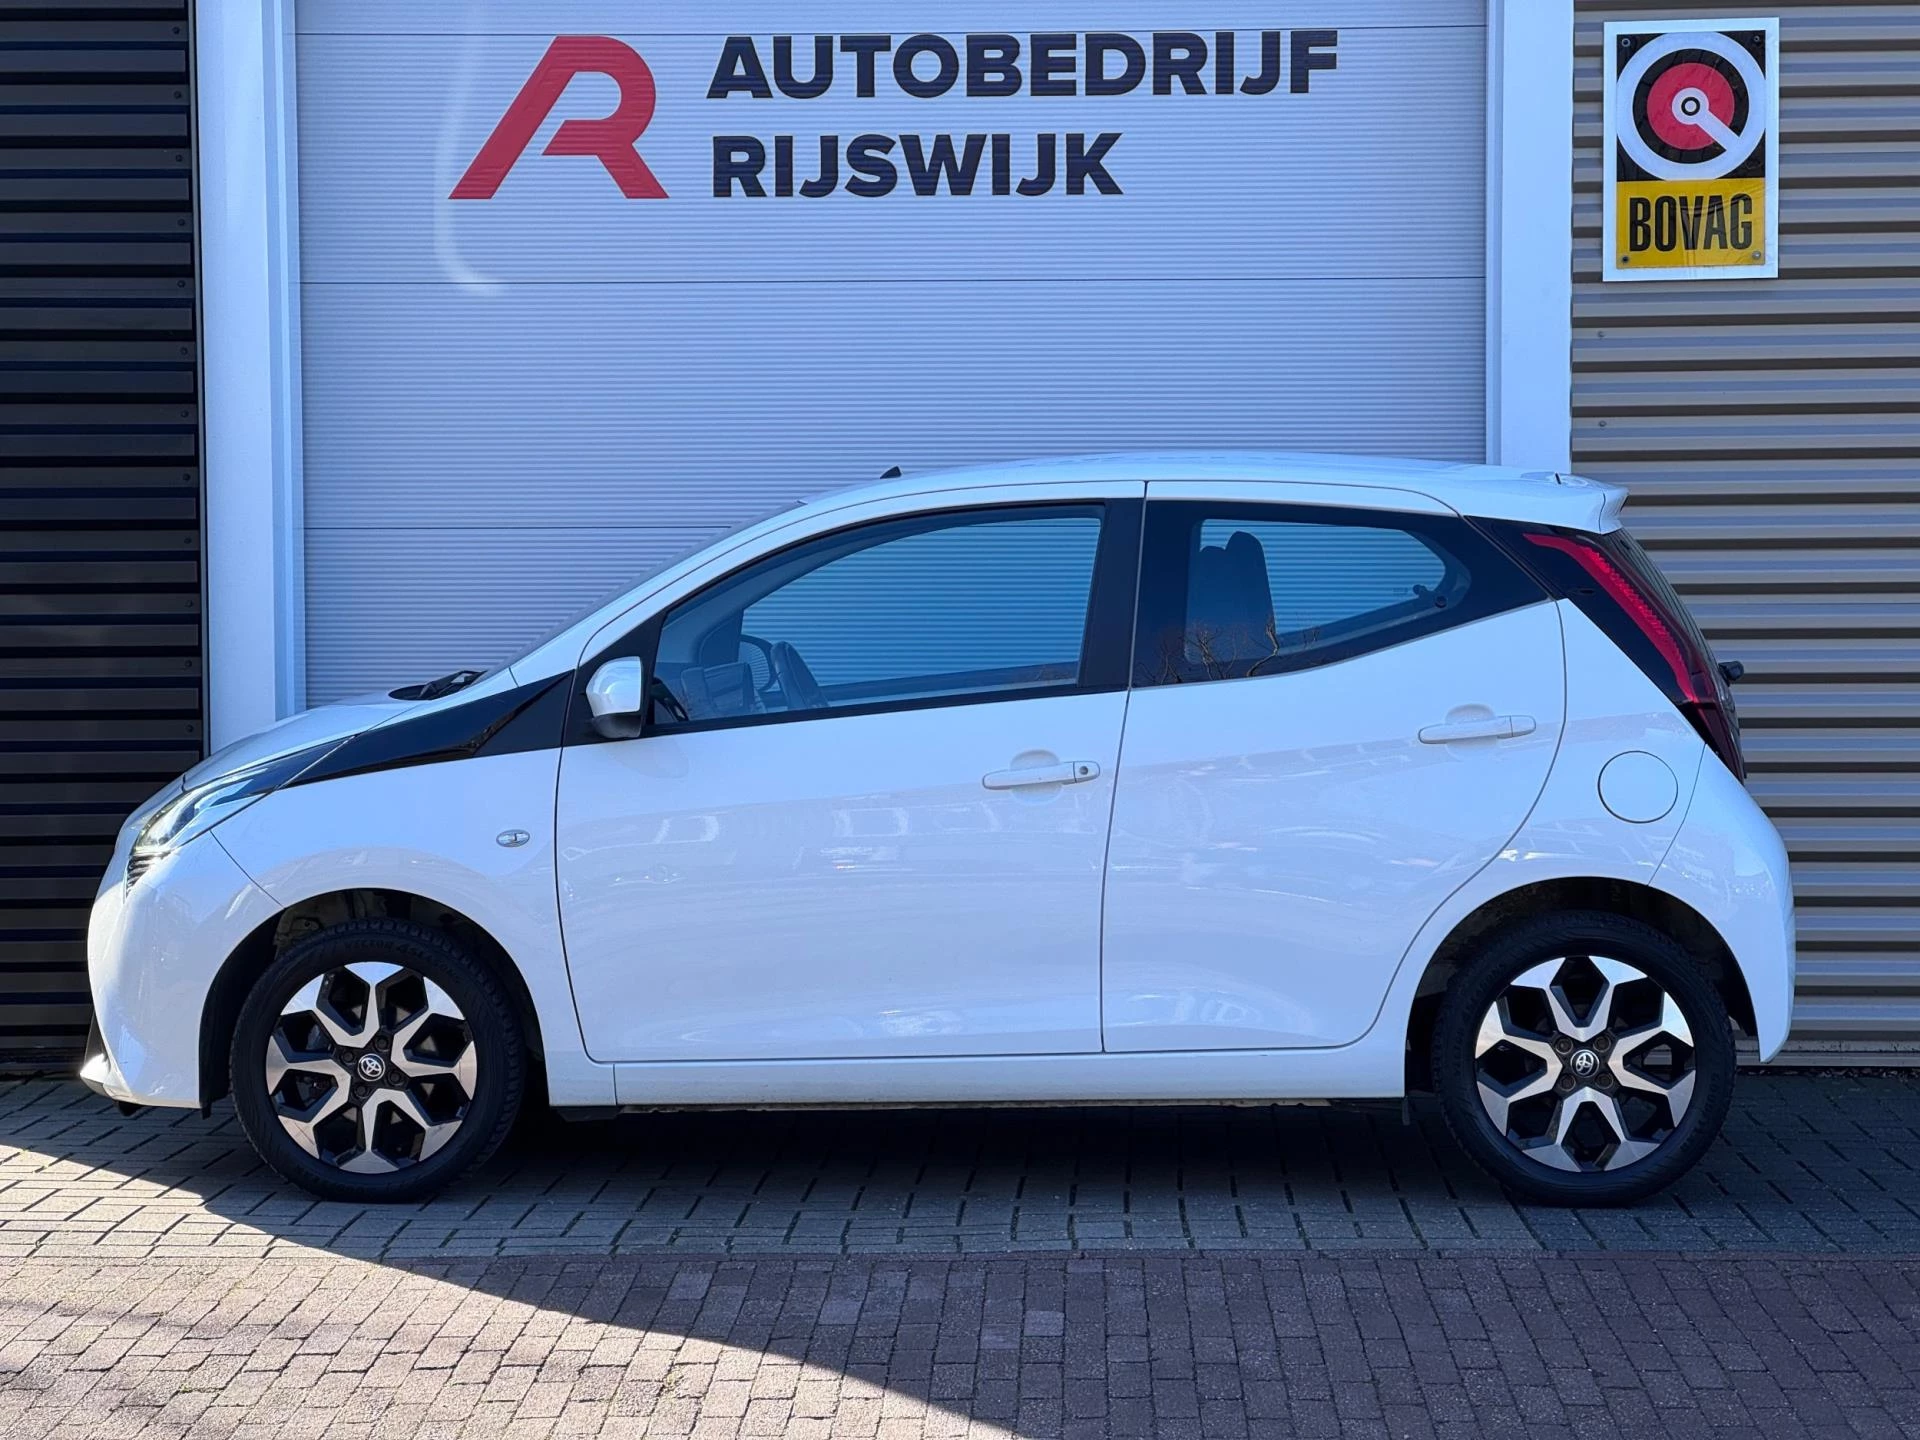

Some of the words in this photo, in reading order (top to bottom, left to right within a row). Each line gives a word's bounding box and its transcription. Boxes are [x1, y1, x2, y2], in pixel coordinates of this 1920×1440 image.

[706, 30, 1338, 99] AUTOBEDRIJF
[712, 132, 1123, 198] RIJSWIJK
[1629, 193, 1753, 252] BOVAG
